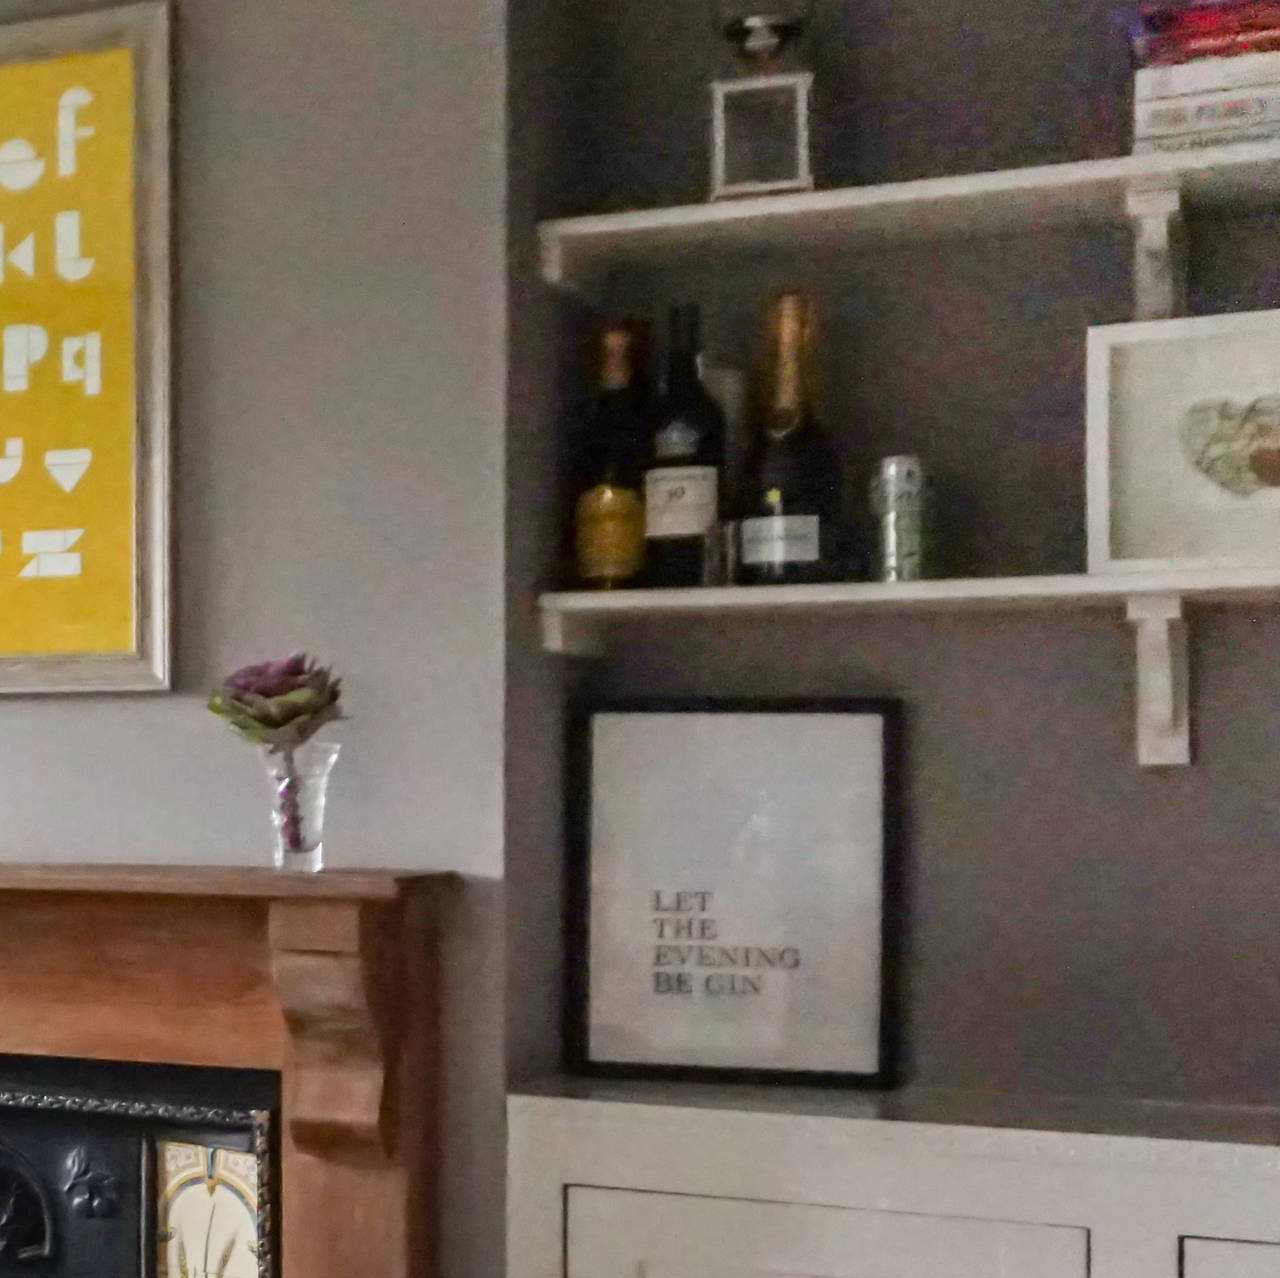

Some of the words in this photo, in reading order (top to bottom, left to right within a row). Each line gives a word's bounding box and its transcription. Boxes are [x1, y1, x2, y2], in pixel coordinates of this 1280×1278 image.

[653, 890, 713, 912] LET
[652, 918, 718, 939] THE
[653, 945, 800, 969] EVENING
